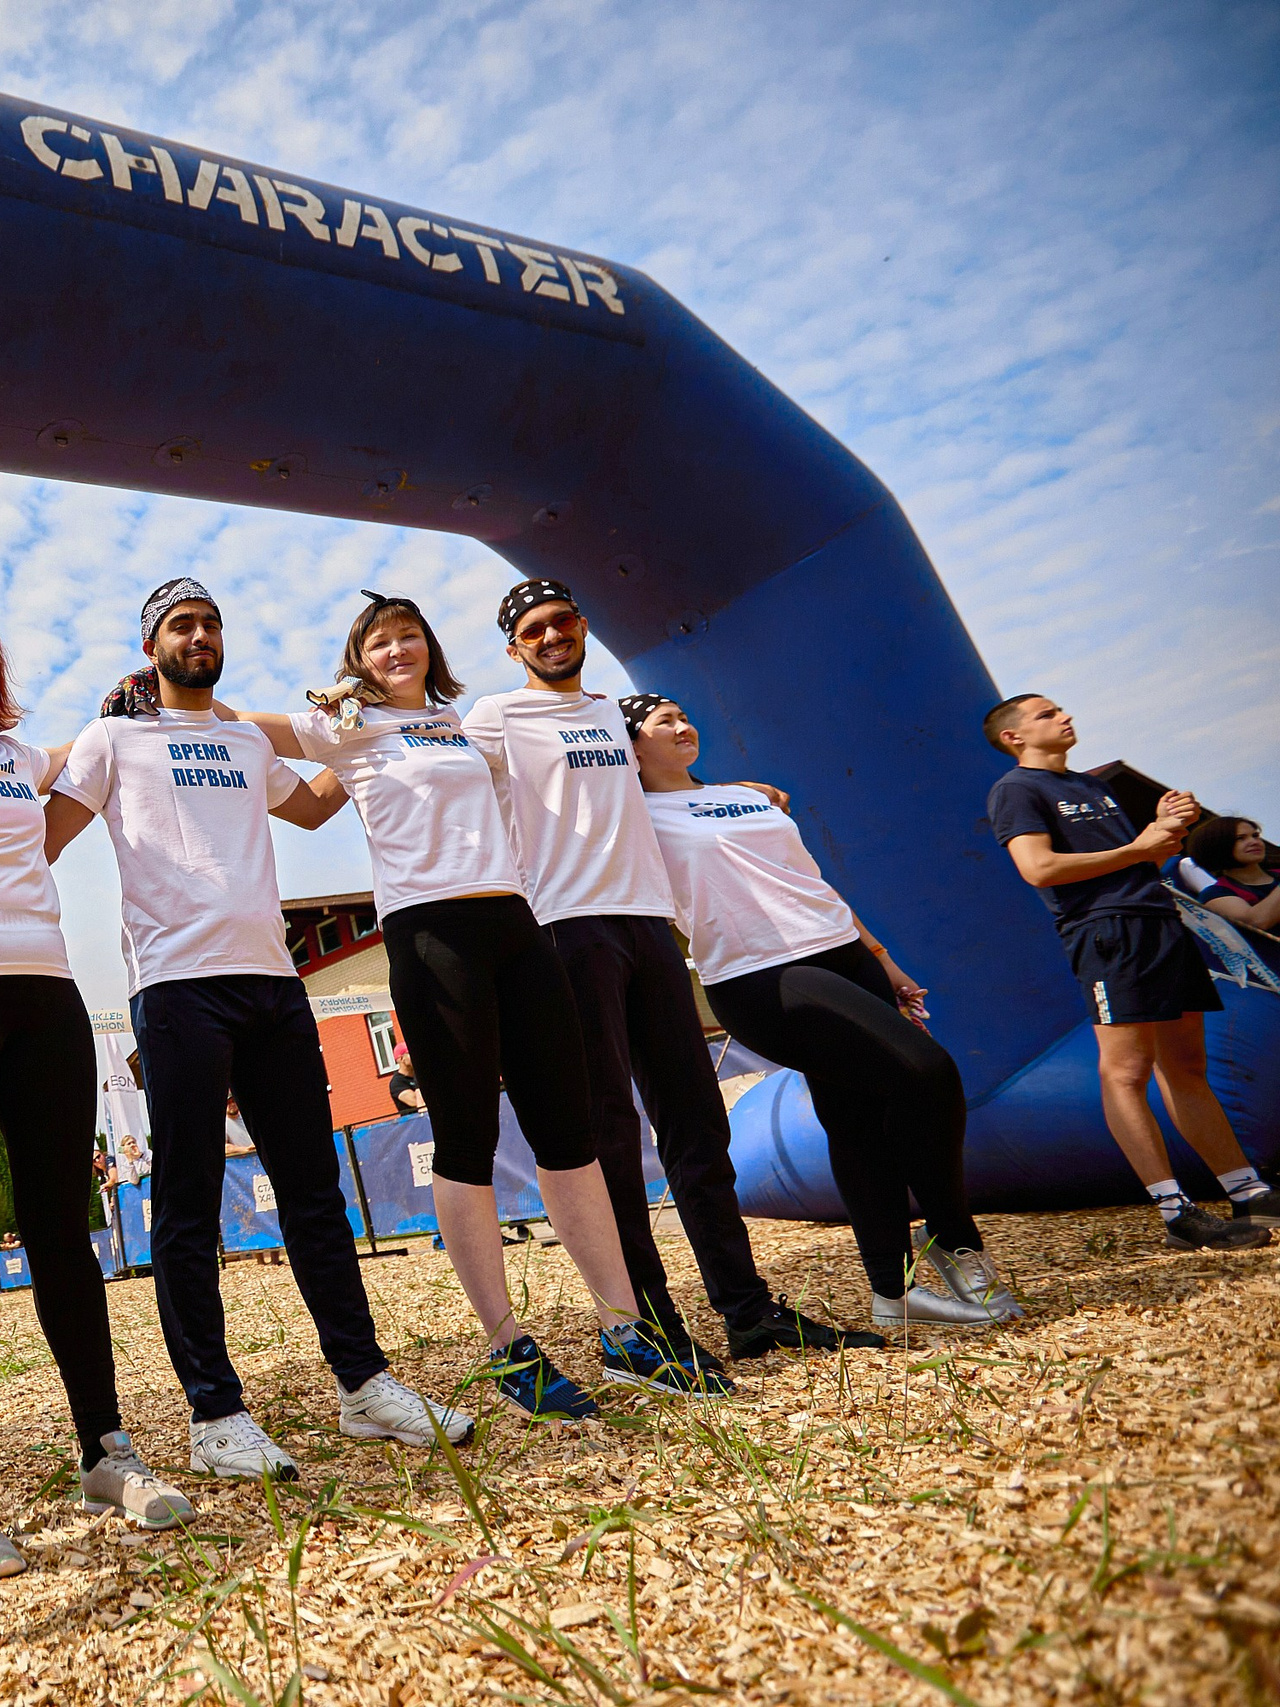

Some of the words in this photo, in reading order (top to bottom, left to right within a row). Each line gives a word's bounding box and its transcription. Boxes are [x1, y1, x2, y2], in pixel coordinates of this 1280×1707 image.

[20, 115, 625, 316] CHARACTER
[558, 728, 614, 744] ВРЕМЯ
[167, 743, 232, 762] ВРЕМЯ
[566, 748, 629, 769] ПЕРВЫХ
[172, 768, 249, 789] ПЕРВЫХ
